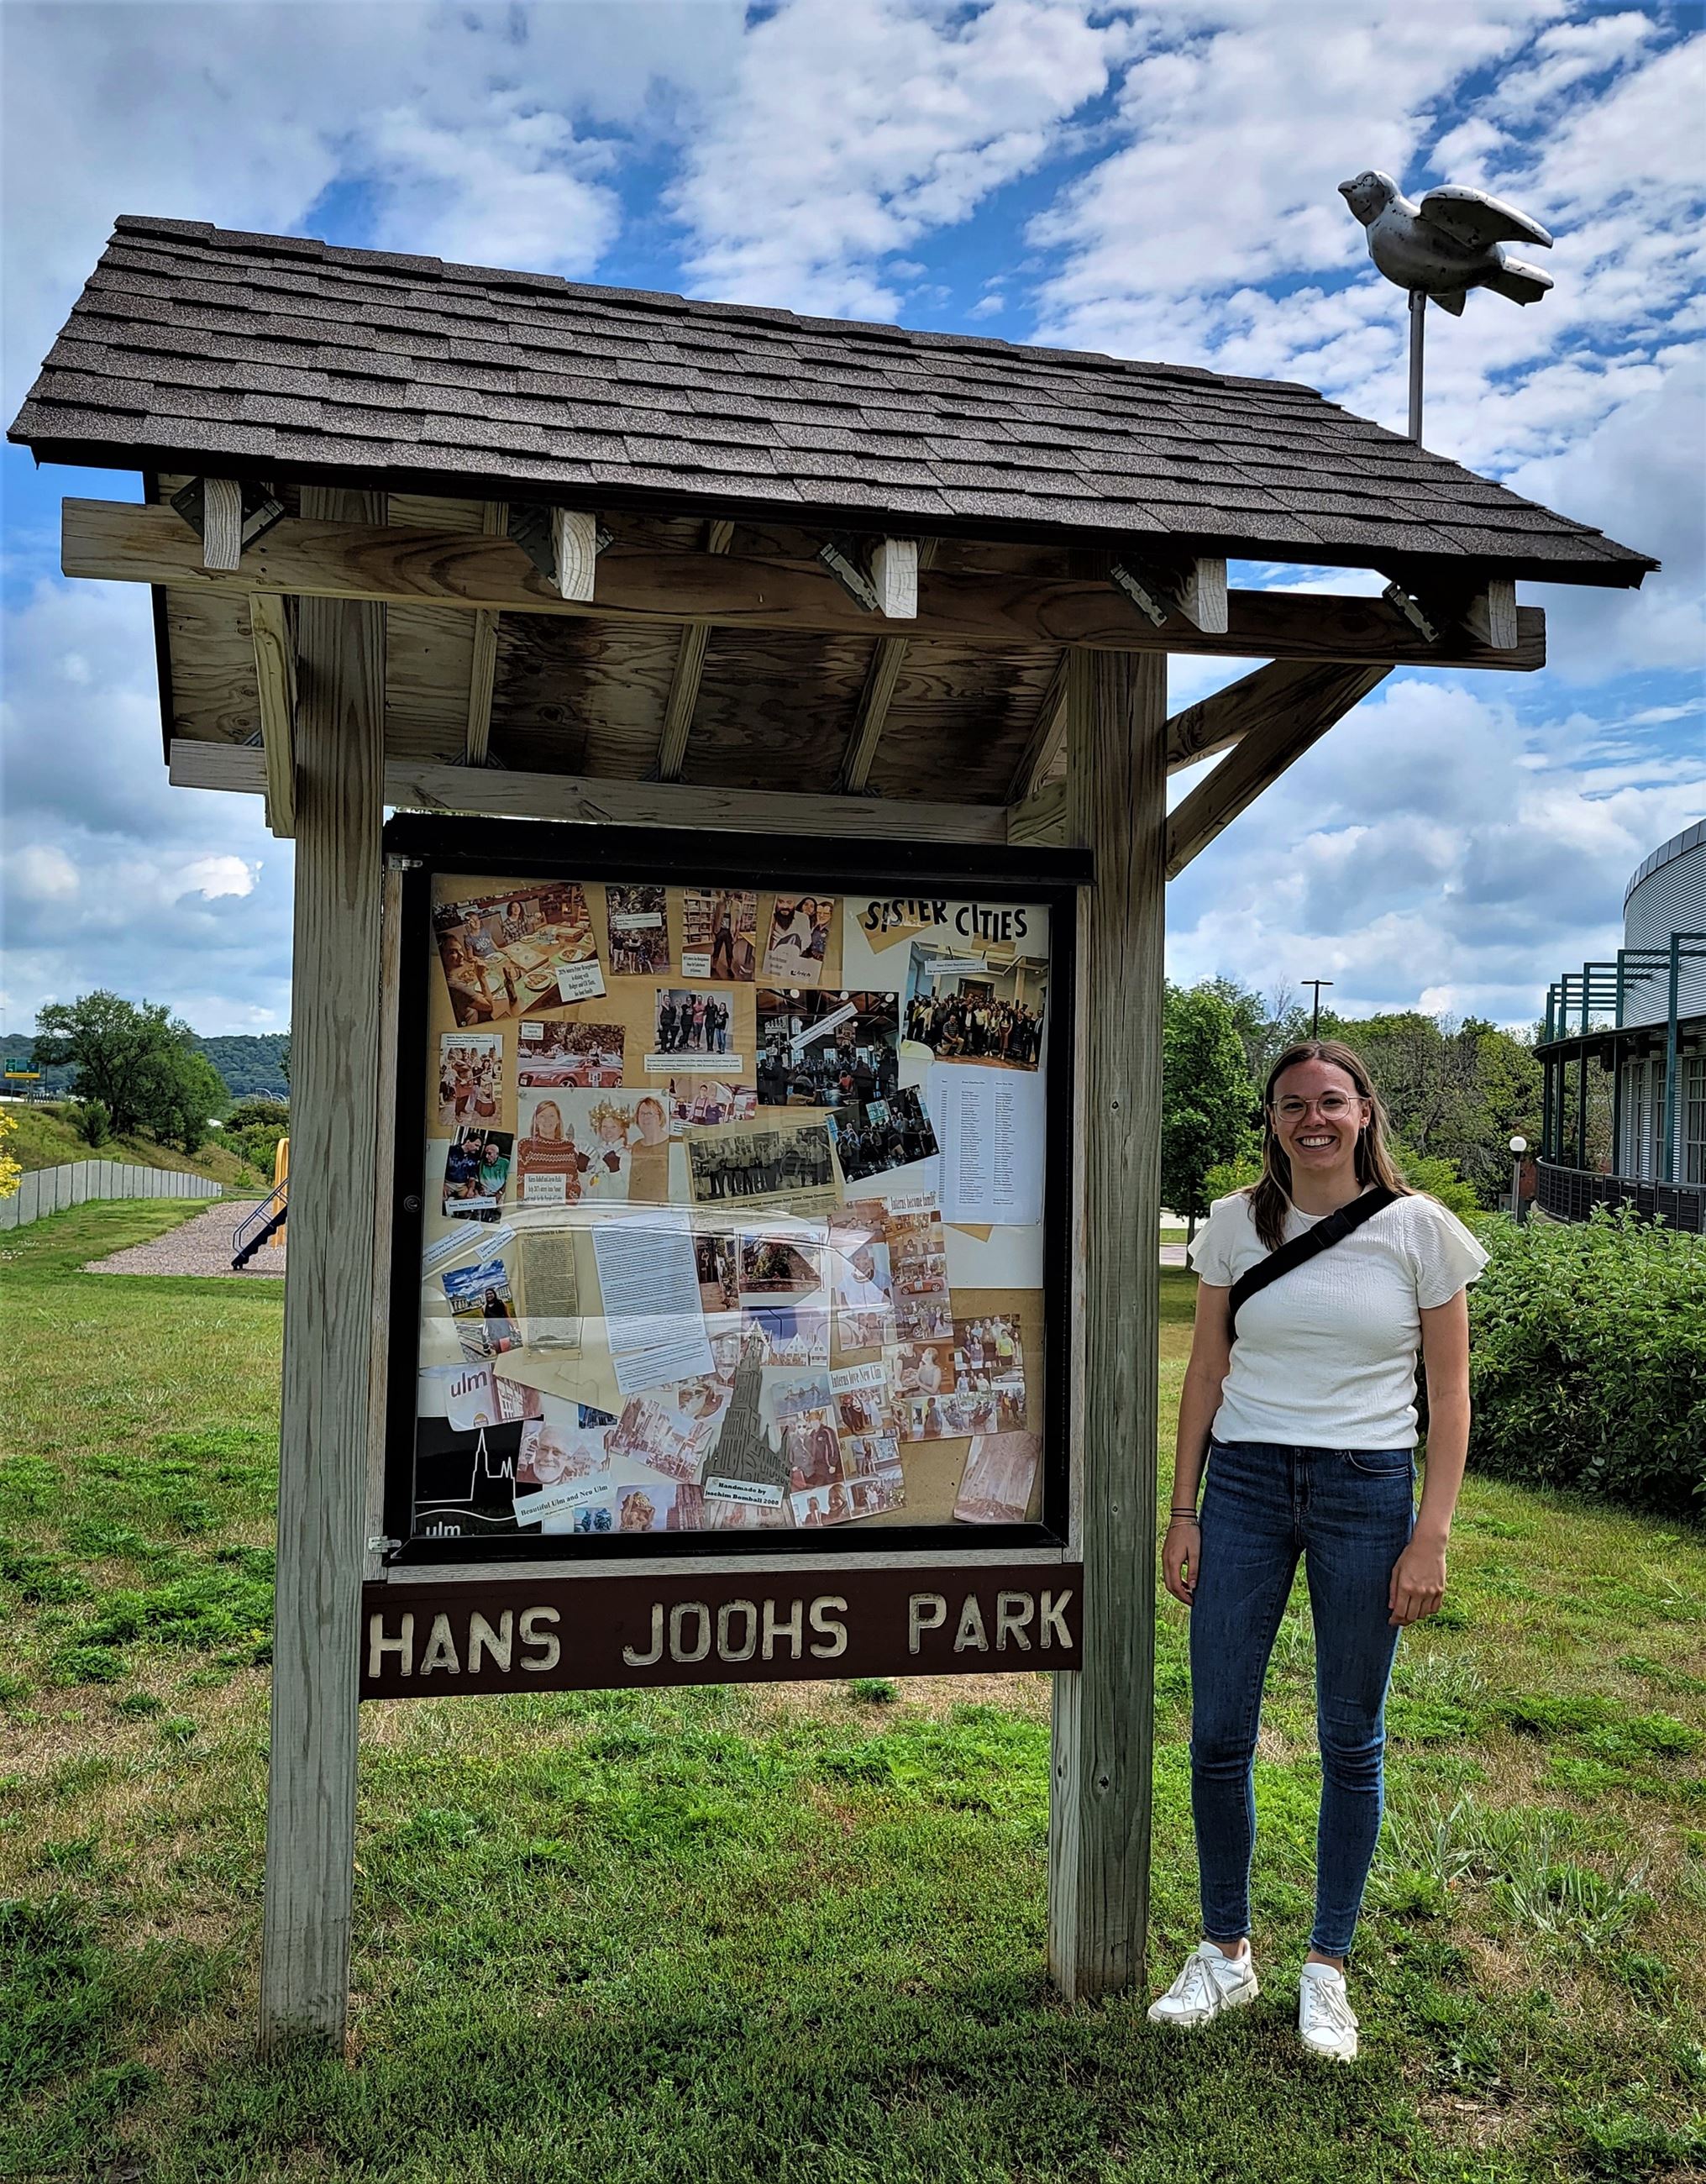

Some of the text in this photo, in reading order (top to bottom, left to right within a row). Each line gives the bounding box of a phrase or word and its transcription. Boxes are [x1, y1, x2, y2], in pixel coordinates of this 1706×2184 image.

[955, 904, 1028, 942] CITIES
[891, 1196, 906, 1210] Interns
[906, 1194, 922, 1208] become
[450, 1370, 487, 1398] ulm
[831, 1374, 849, 1388] Interns
[848, 1370, 859, 1384] love
[859, 1368, 870, 1382] New
[705, 1490, 731, 1499] Joachim
[732, 1494, 762, 1503] Bomball
[719, 1483, 756, 1493] Handmade
[521, 1502, 550, 1516] Beautiful
[551, 1499, 565, 1507] Ulm
[567, 1494, 579, 1502] and
[426, 1521, 461, 1536] ulm
[369, 1589, 1073, 1677] HANS JOOHS PARK
